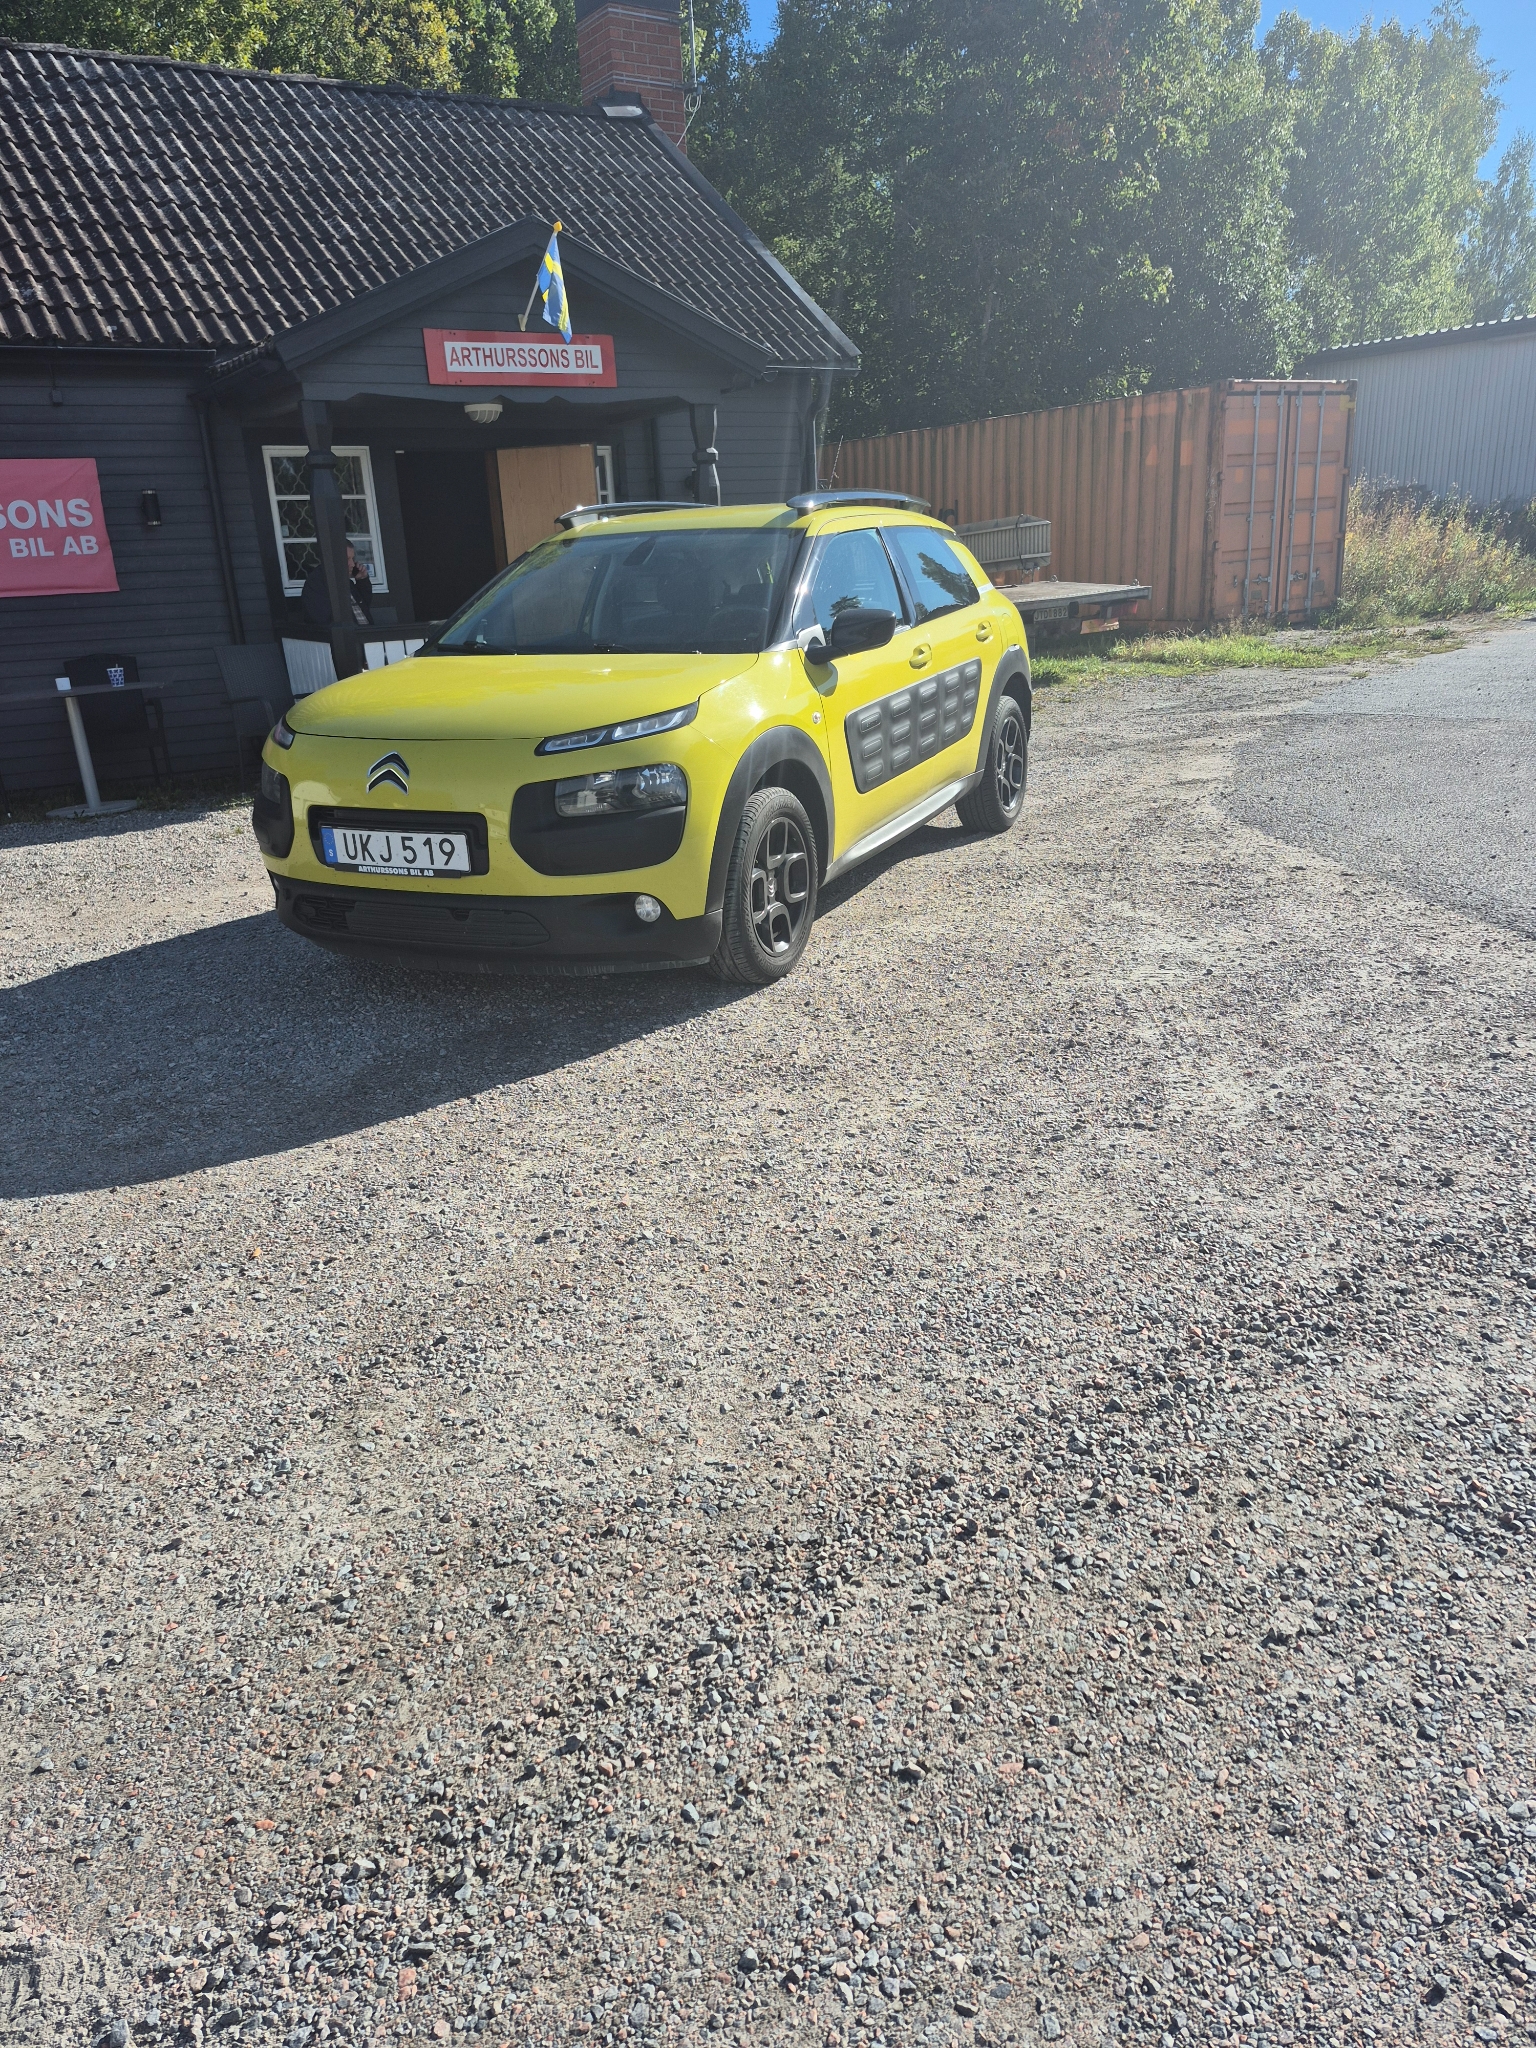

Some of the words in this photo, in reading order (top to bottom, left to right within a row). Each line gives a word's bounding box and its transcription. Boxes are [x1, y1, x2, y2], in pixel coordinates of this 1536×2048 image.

[450, 346, 570, 369] ARTHURSSONS
[574, 349, 599, 369] BIL
[0, 498, 93, 530] ONS
[9, 537, 55, 558] BIL
[63, 535, 99, 556] AB
[1035, 610, 1048, 620] JTD
[1053, 608, 1067, 618] 882
[329, 849, 334, 857] S
[342, 832, 392, 863] UKJ
[400, 836, 456, 866] 519
[358, 865, 408, 875] ARTHURSSONS
[409, 868, 422, 876] BIL
[423, 869, 434, 877] AB
